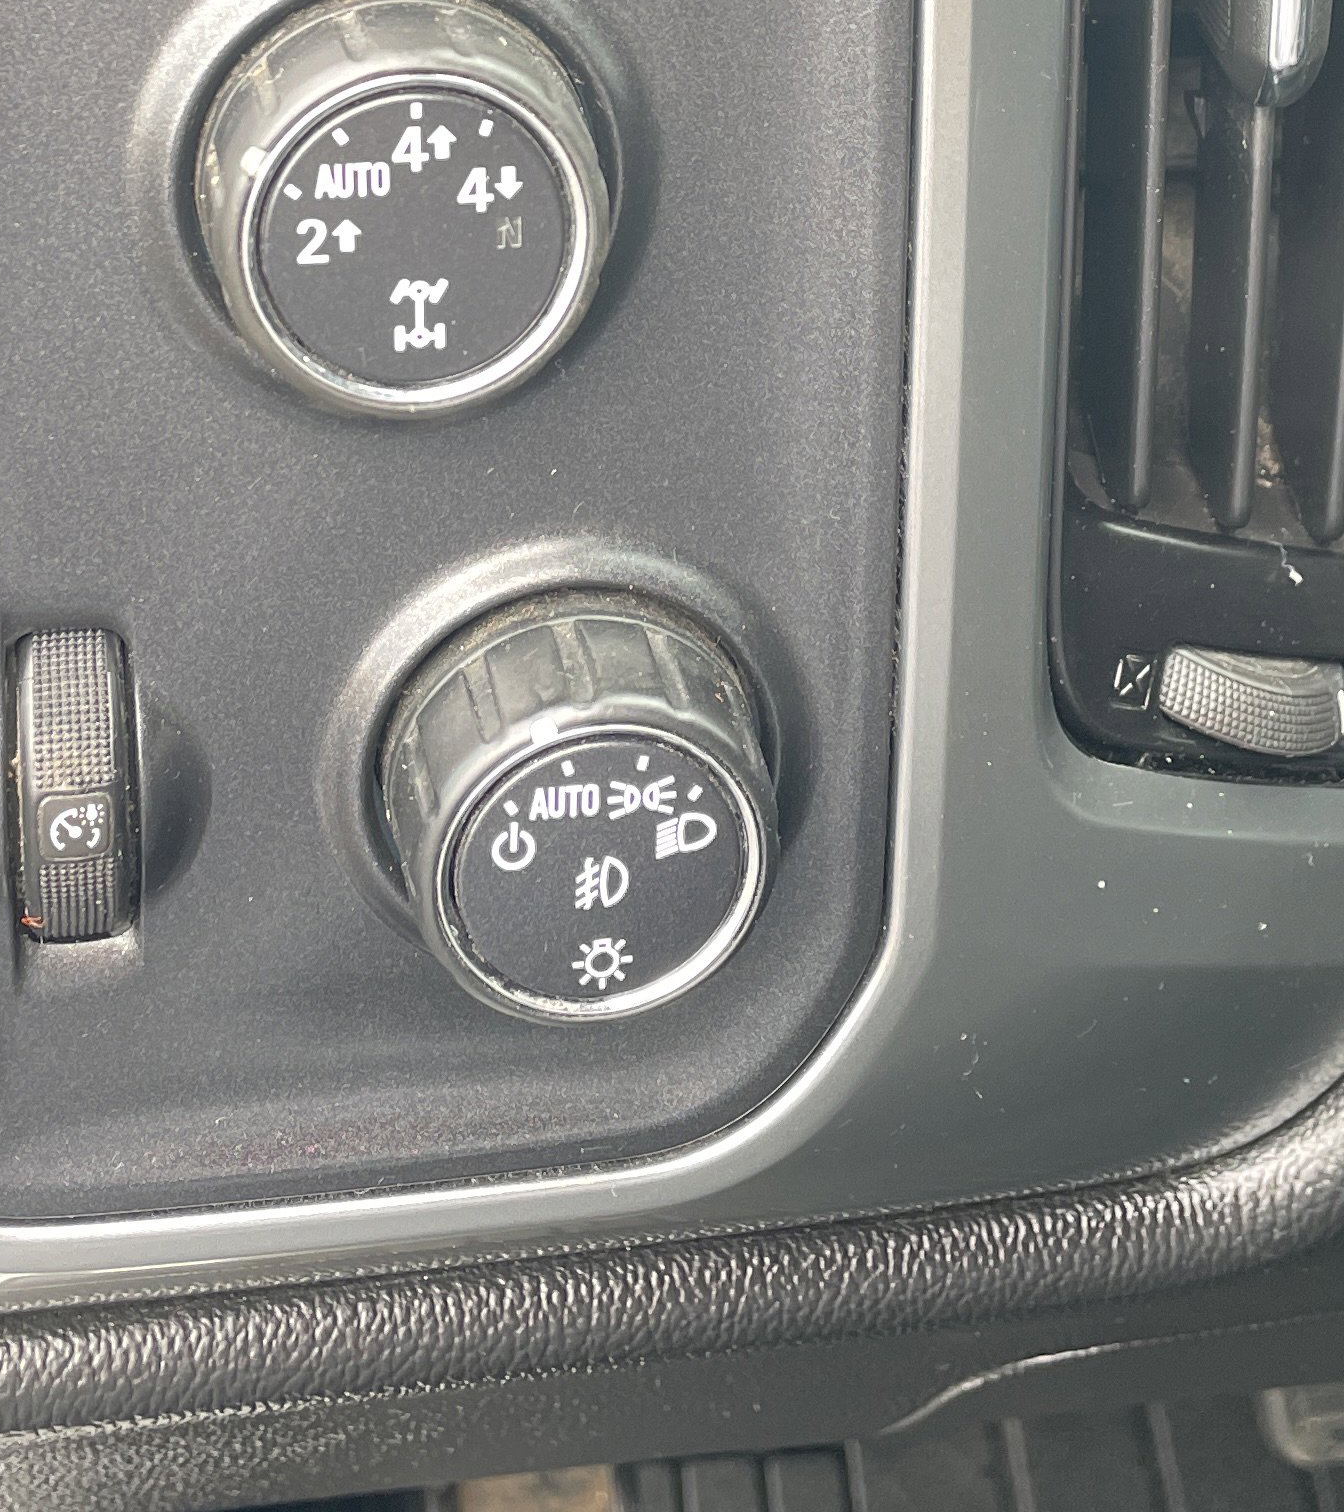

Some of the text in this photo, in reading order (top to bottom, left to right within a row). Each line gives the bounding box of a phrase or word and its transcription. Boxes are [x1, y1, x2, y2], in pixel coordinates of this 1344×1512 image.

[391, 125, 430, 173] 4
[314, 161, 391, 200] AUTO
[457, 166, 494, 213] 4
[295, 218, 330, 265] 2
[528, 783, 600, 821] AUTO
